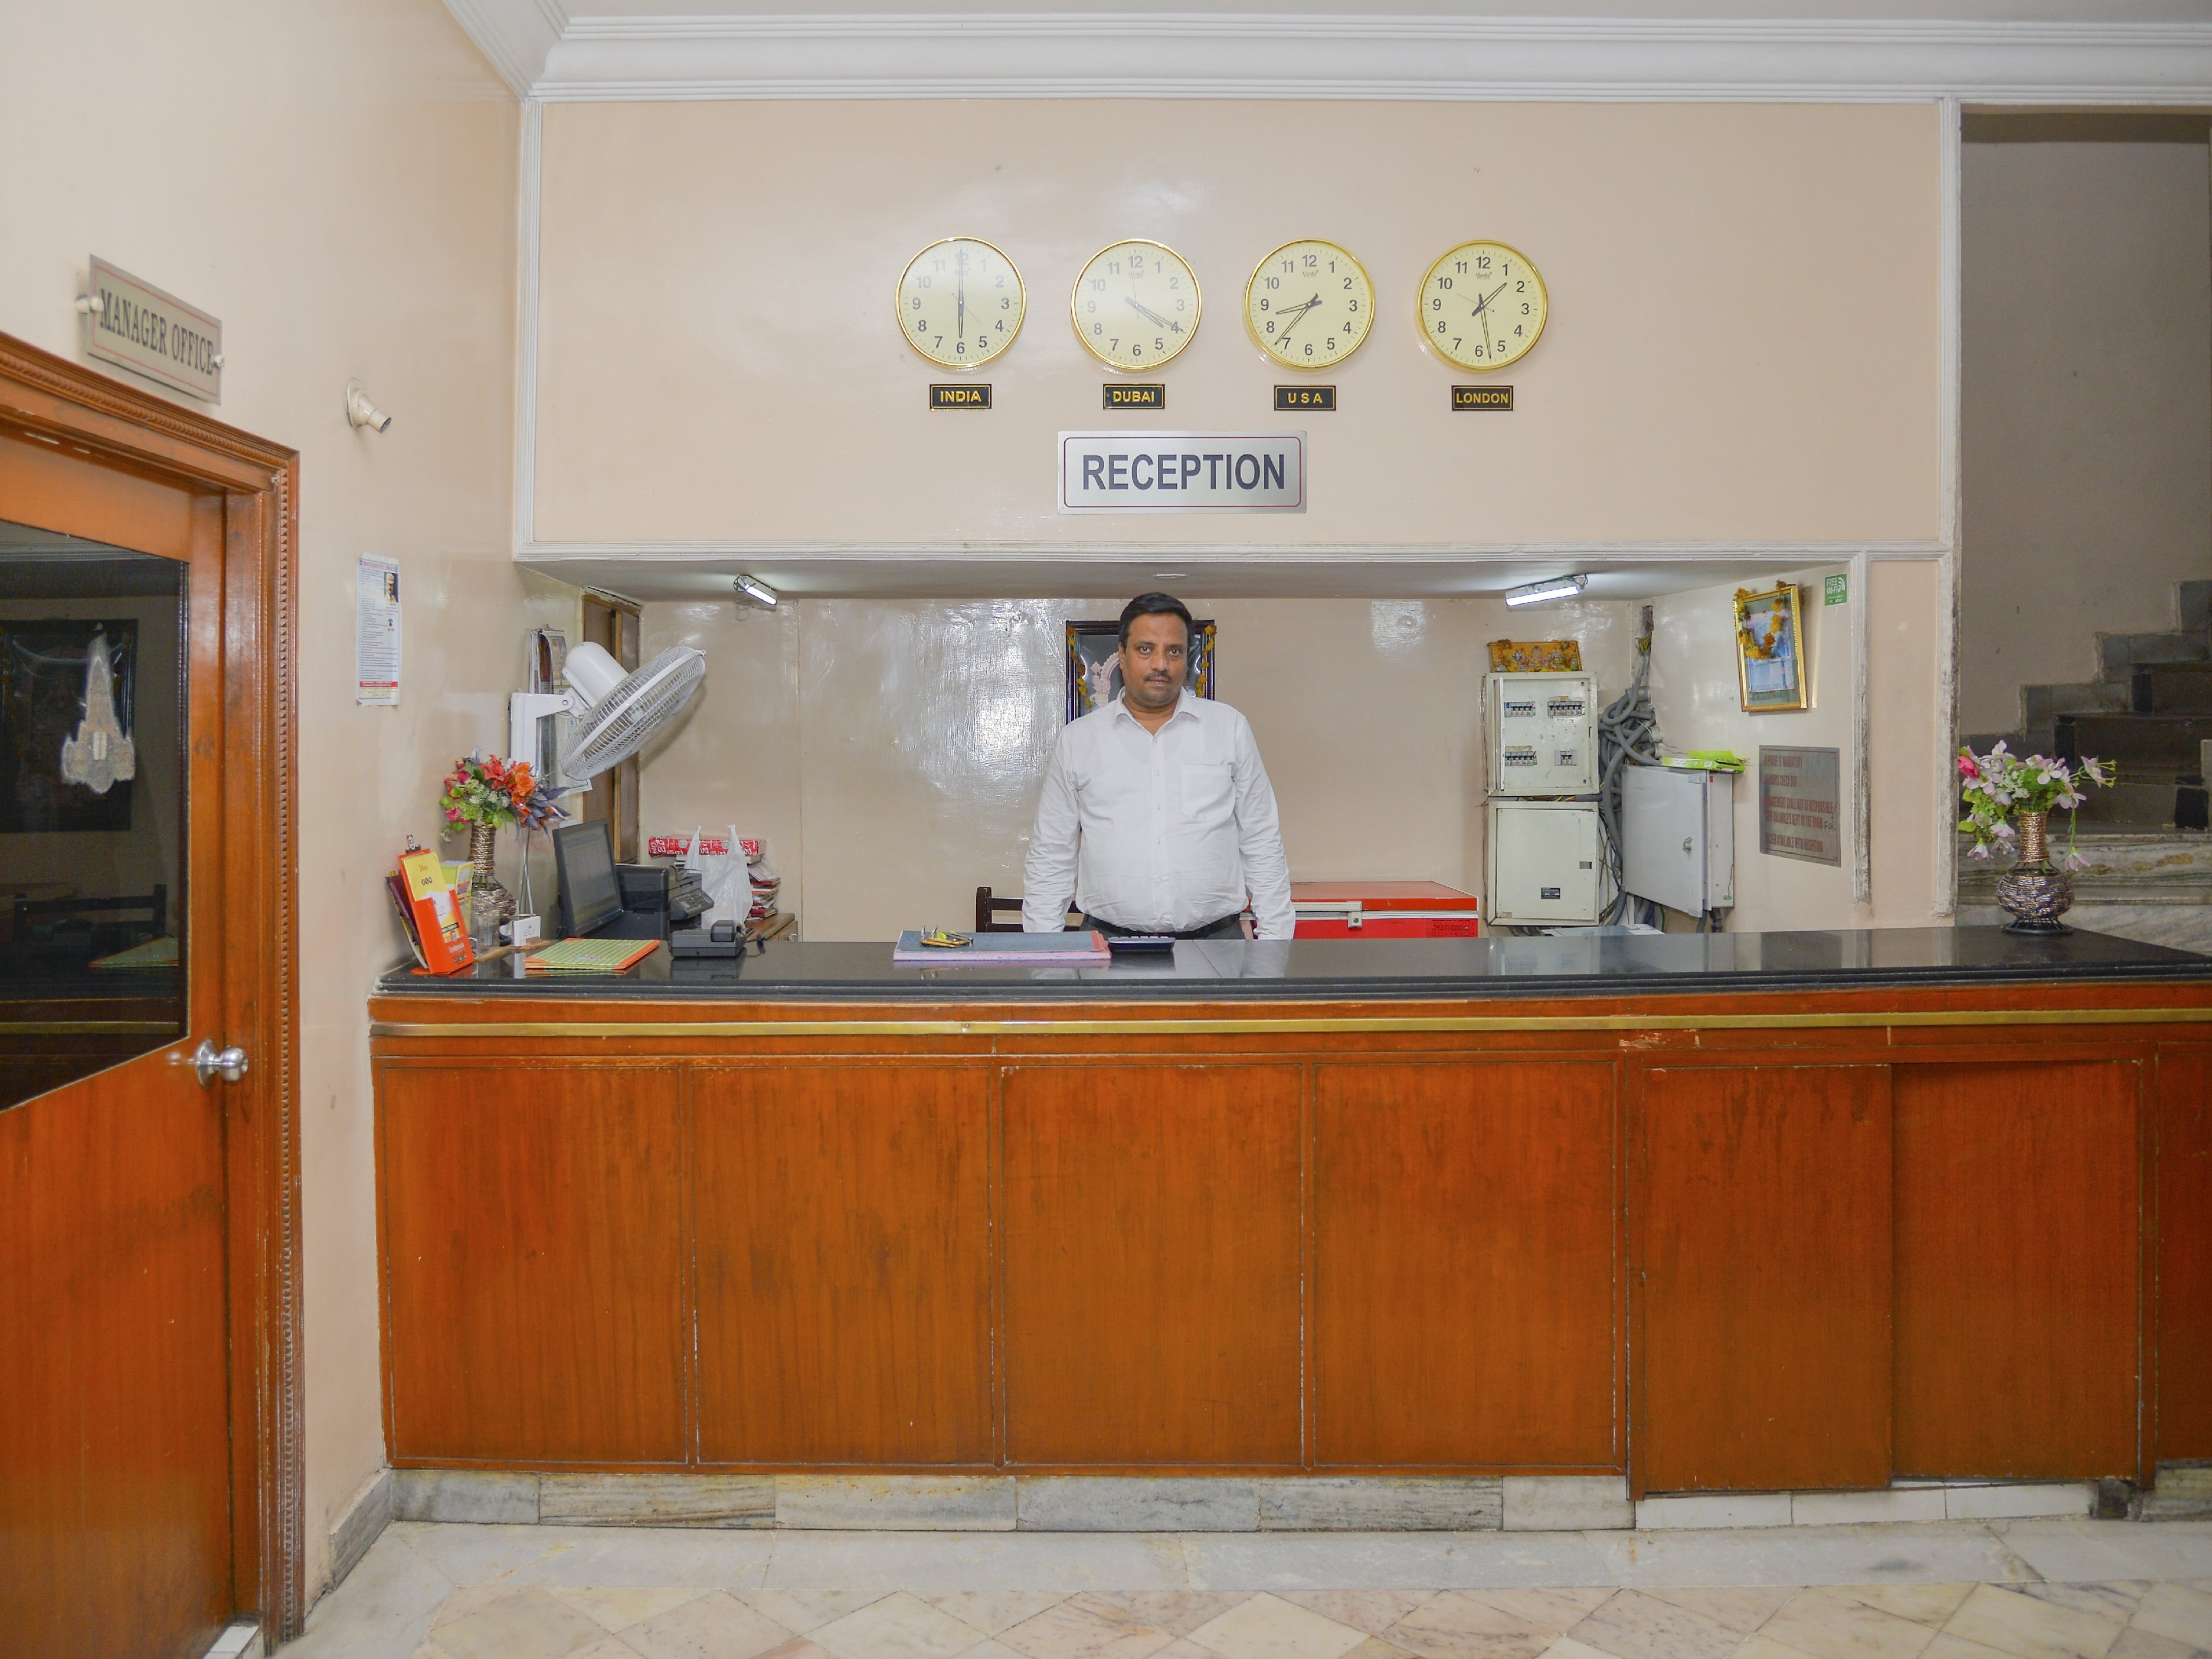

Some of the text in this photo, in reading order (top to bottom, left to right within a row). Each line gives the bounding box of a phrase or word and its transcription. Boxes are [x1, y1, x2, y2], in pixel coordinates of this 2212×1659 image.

[933, 258, 945, 271] 11
[954, 253, 969, 266] 12
[980, 258, 986, 271] 1
[1128, 256, 1143, 268] 12
[1303, 255, 1317, 267] 12
[1476, 257, 1490, 269] 12
[1107, 262, 1119, 274] 11
[1155, 261, 1160, 273] 1
[1282, 260, 1293, 273] 11
[1329, 261, 1334, 273] 1
[1455, 262, 1467, 274] 11
[1503, 264, 1507, 276] 1
[916, 276, 931, 288] 10
[996, 276, 1004, 288] 2
[1091, 279, 1105, 291] 10
[1170, 277, 1179, 289] 2
[1265, 277, 1279, 289] 10
[1344, 277, 1352, 289] 2
[1438, 277, 1452, 289] 10
[1516, 281, 1524, 292] 2
[913, 297, 921, 309] 9
[1001, 298, 1009, 309] 3
[1088, 301, 1096, 313] 9
[1177, 299, 1184, 312] 3
[1261, 299, 1268, 310] 9
[1349, 300, 1357, 312] 3
[1433, 299, 1441, 310] 9
[1521, 303, 1529, 315] 3
[918, 320, 927, 332] 8
[996, 320, 1003, 332] 4
[1094, 323, 1102, 335] 8
[1170, 321, 1179, 333] 4
[1267, 321, 1274, 333] 8
[1343, 322, 1351, 333] 4
[1438, 321, 1445, 333] 8
[1514, 325, 1522, 336] 4
[100, 288, 214, 377] MANAGER OFFICE
[935, 336, 943, 348] 7
[957, 342, 964, 354] 6
[979, 336, 987, 348] 5
[1110, 339, 1118, 351] 7
[1155, 338, 1163, 350] 5
[1282, 338, 1291, 349] 7
[1327, 338, 1334, 350] 5
[1454, 338, 1461, 350] 7
[1497, 341, 1505, 352] 5
[1133, 345, 1141, 356] 6
[1305, 344, 1313, 355] 6
[1475, 345, 1483, 357] 6
[940, 391, 981, 403] INDIA
[1113, 391, 1154, 403] DUBAI
[1455, 392, 1509, 404] LONDON
[1083, 454, 1284, 490] RECEPTION
[1826, 577, 1838, 587] FREE
